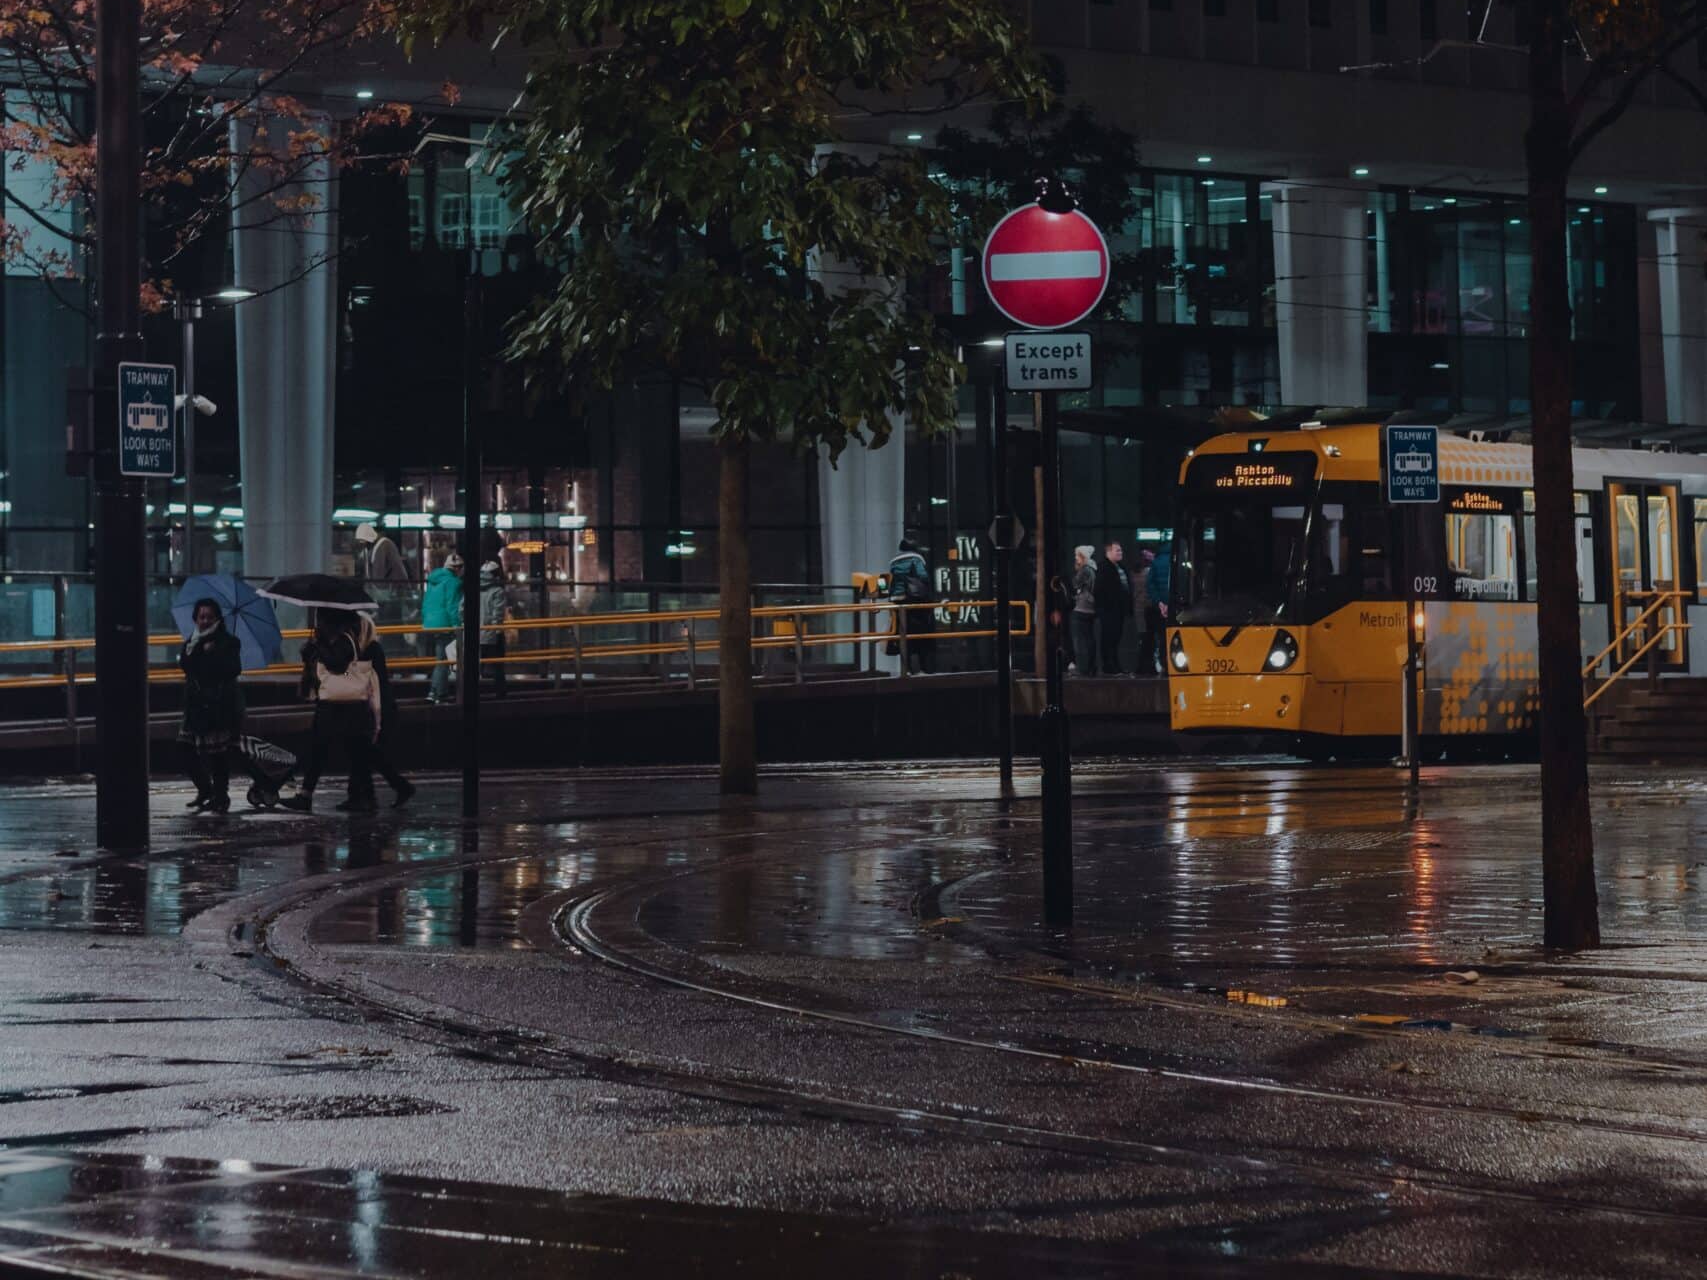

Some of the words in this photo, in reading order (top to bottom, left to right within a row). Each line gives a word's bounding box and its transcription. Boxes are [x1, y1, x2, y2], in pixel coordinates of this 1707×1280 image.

[1016, 343, 1083, 360] Except
[126, 371, 168, 385] TRAMWAY
[1021, 365, 1078, 380] trams
[1394, 431, 1432, 441] TRAMWAY
[124, 437, 147, 451] LOOK
[149, 438, 171, 452] BOTH
[136, 454, 160, 468] WAYS
[1235, 464, 1275, 476] Ashton
[1216, 476, 1234, 487] via
[1237, 474, 1293, 487] Piccadilly
[1392, 476, 1414, 486] LOOK
[1415, 476, 1436, 486] BOTH
[1403, 487, 1425, 497] WAYS
[1413, 576, 1437, 593] 092
[1360, 611, 1408, 627] Metrolin
